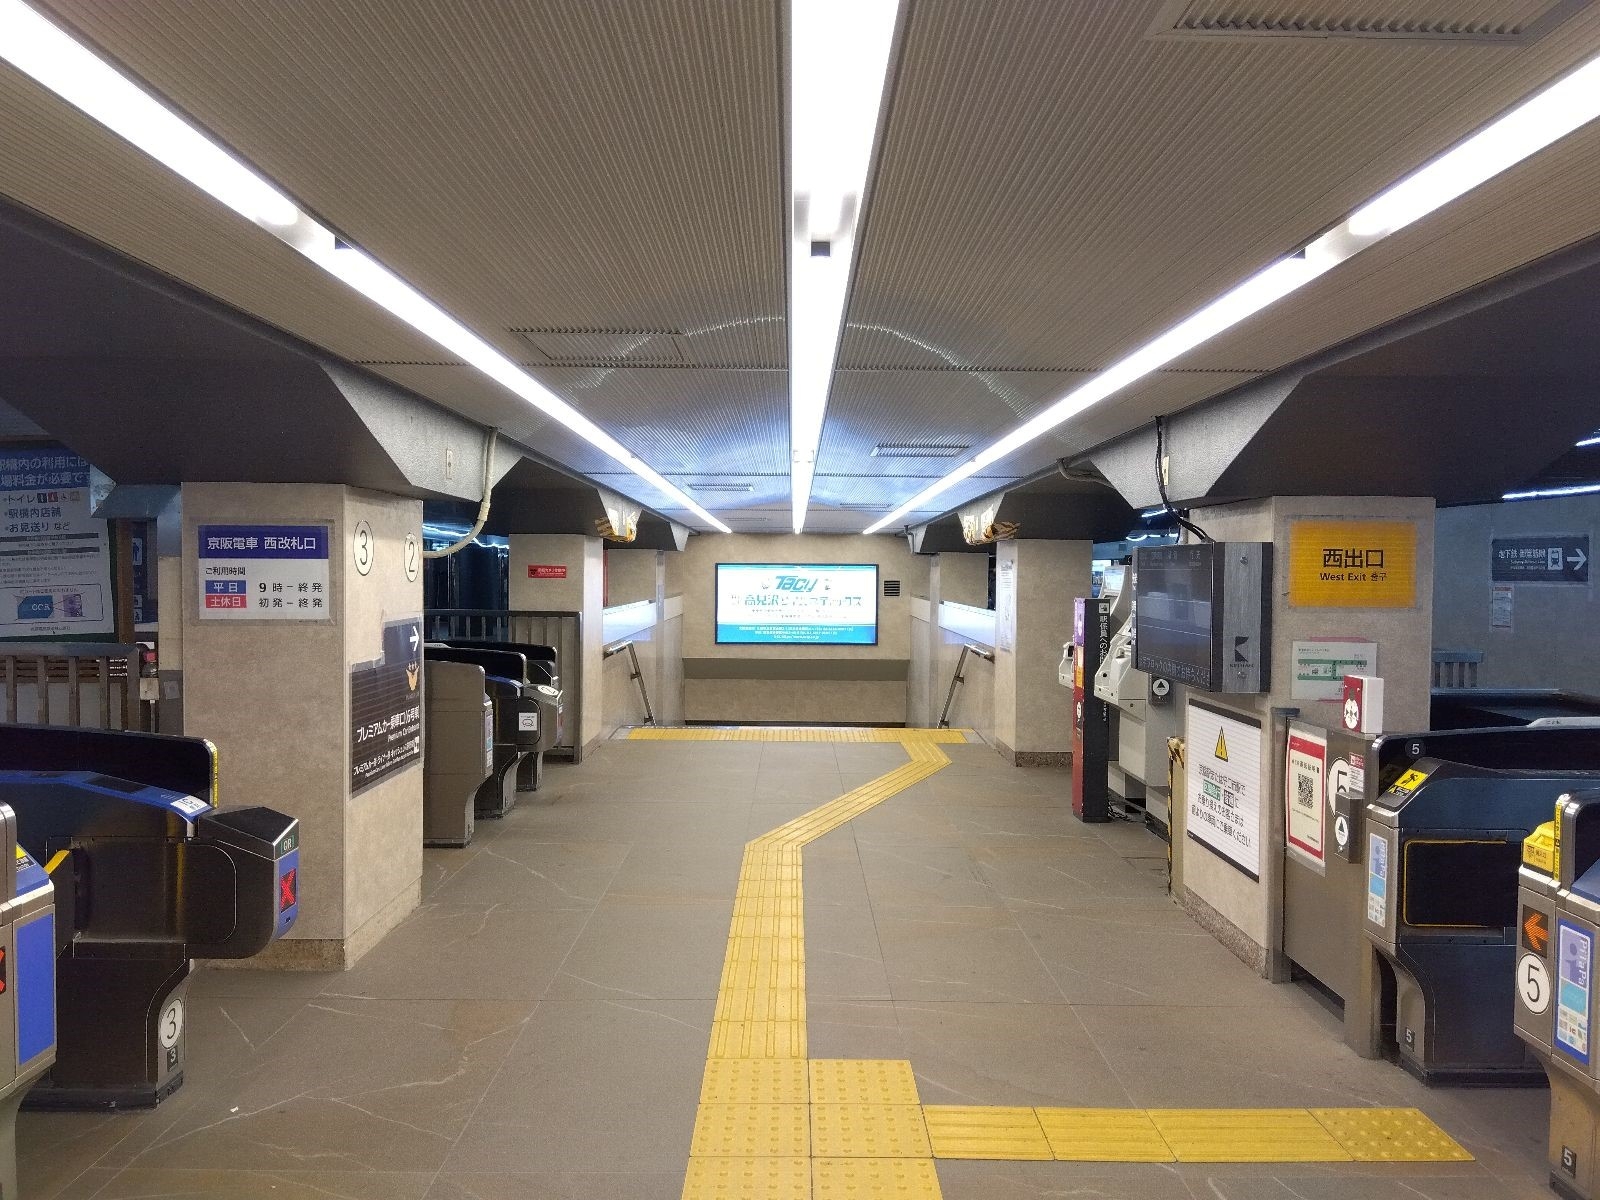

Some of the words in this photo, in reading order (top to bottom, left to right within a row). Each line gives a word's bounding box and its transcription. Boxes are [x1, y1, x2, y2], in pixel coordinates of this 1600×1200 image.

[207, 536, 259, 550] 京阪電車
[263, 536, 316, 550] 西改札口
[359, 529, 369, 566] 3
[408, 540, 416, 573] 2
[1322, 548, 1384, 569] 西出口
[205, 566, 246, 576] ご利用時間
[1319, 572, 1345, 581] West
[1347, 572, 1367, 581] Exit
[210, 596, 242, 608] 土休日
[1411, 743, 1420, 755] 5
[1527, 963, 1540, 1003] 5
[166, 1007, 177, 1040] 3
[170, 1047, 177, 1064] 3
[1564, 1147, 1573, 1167] 5
